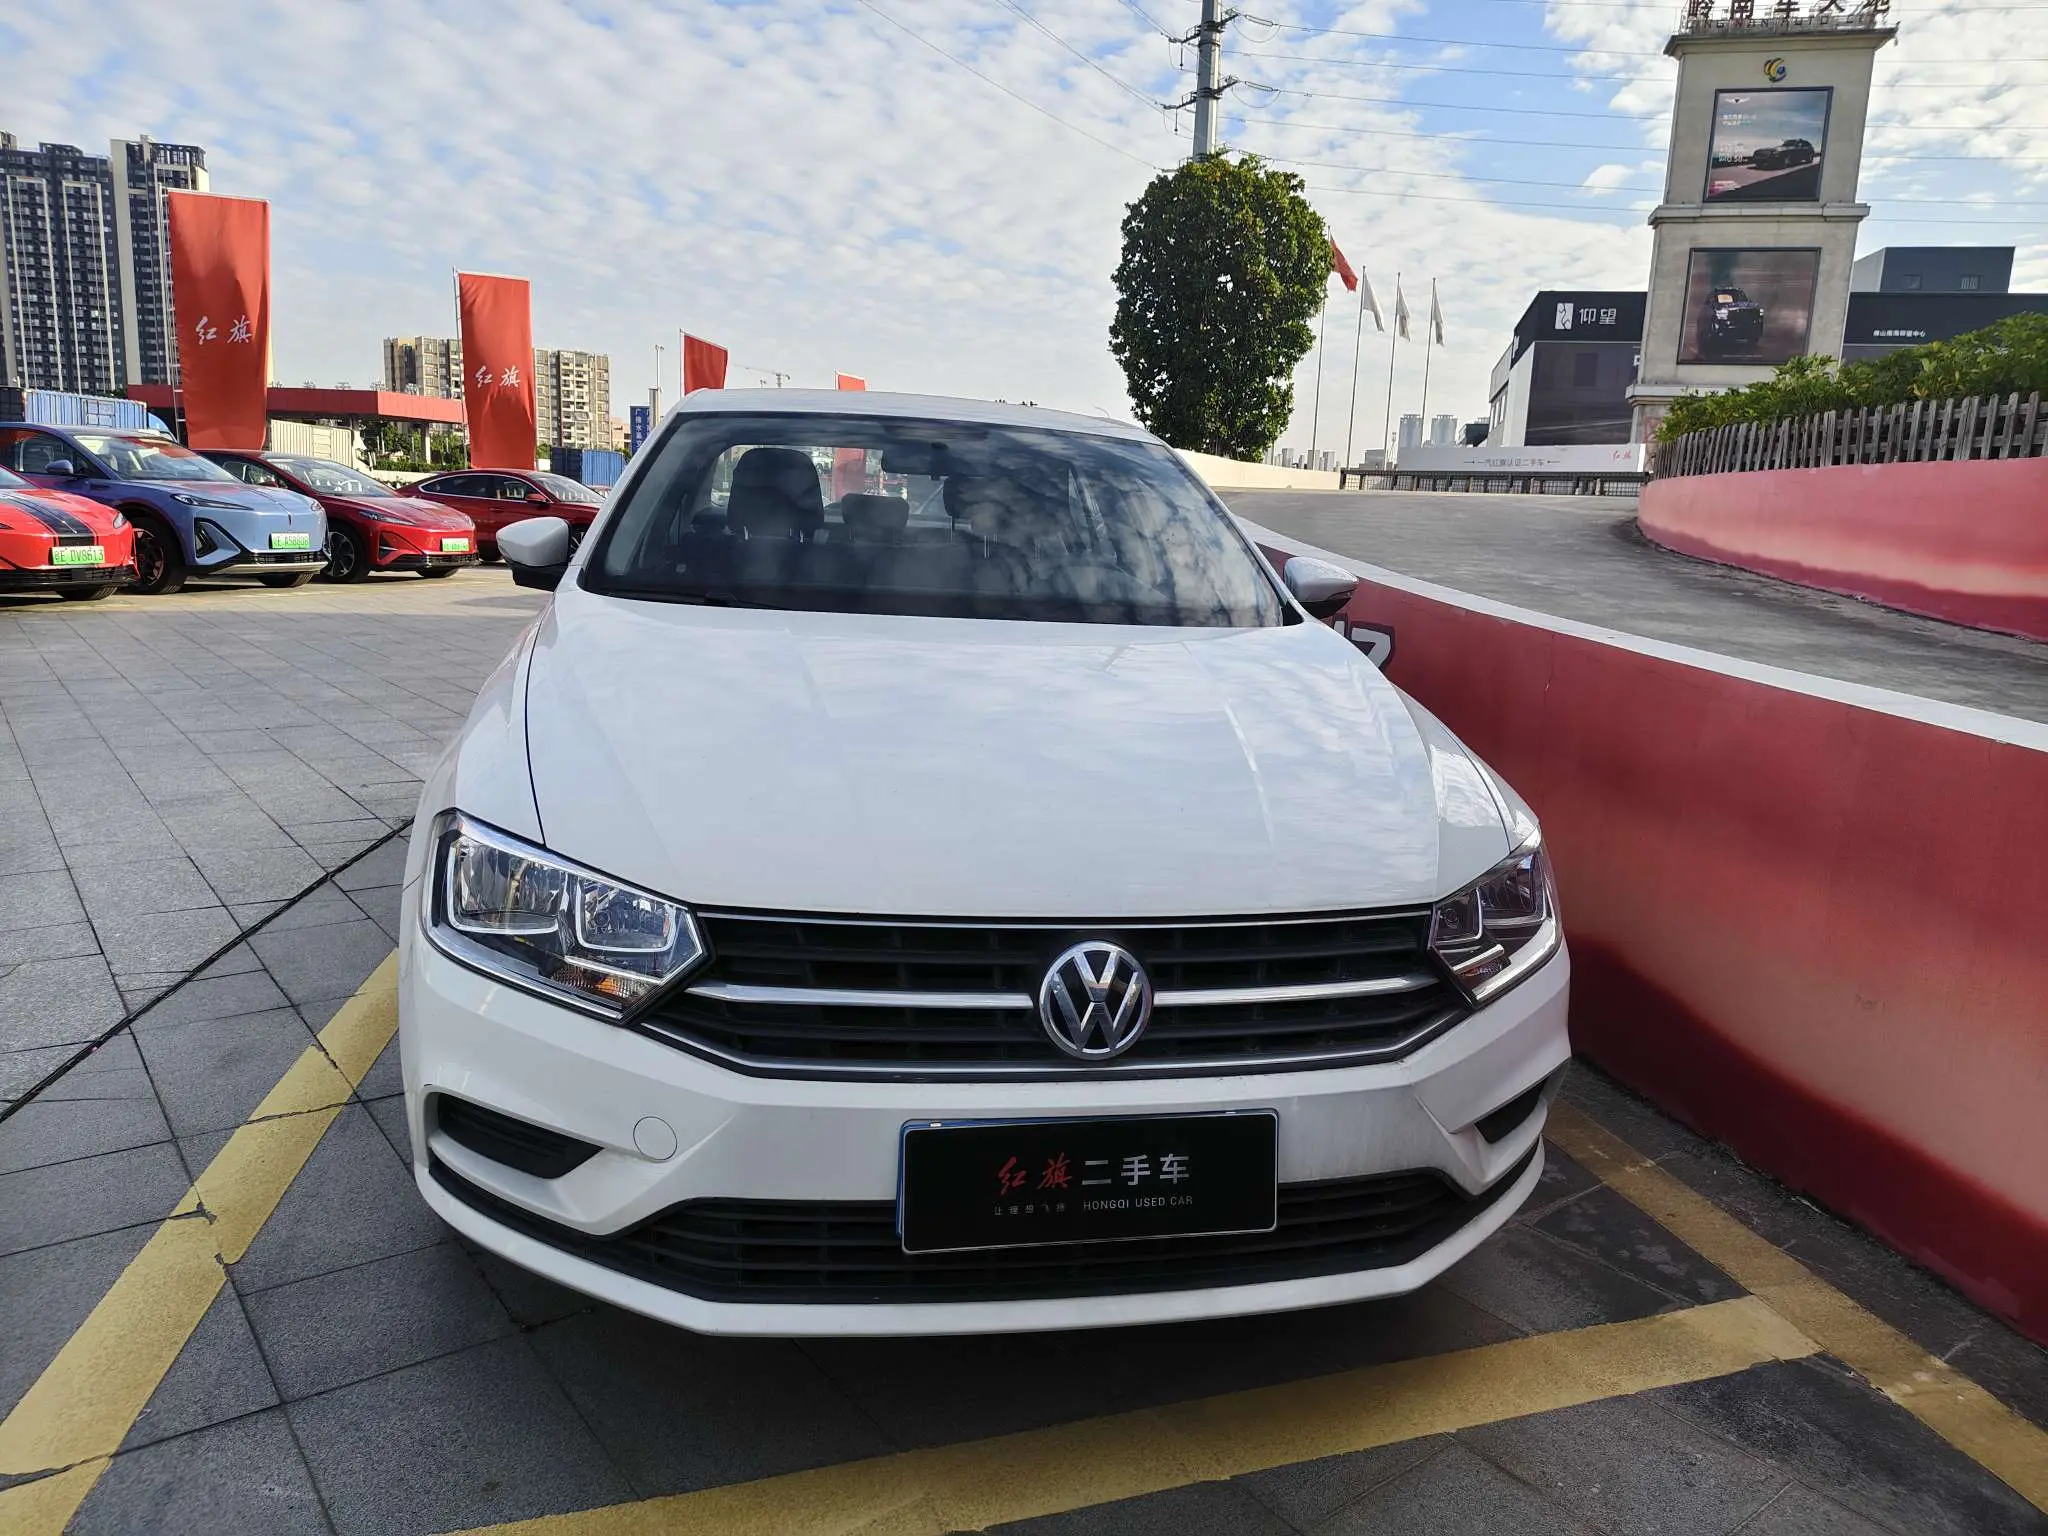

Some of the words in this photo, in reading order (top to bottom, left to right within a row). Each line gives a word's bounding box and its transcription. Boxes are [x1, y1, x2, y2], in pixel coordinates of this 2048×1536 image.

[1579, 308, 1617, 325] 仰望
[195, 314, 252, 345] 红旗
[474, 364, 521, 388] 红旗
[1044, 945, 1148, 1056] VW
[1083, 1199, 1130, 1211] HONGQI
[1135, 1196, 1166, 1208] USED
[1170, 1195, 1193, 1206] CAR
